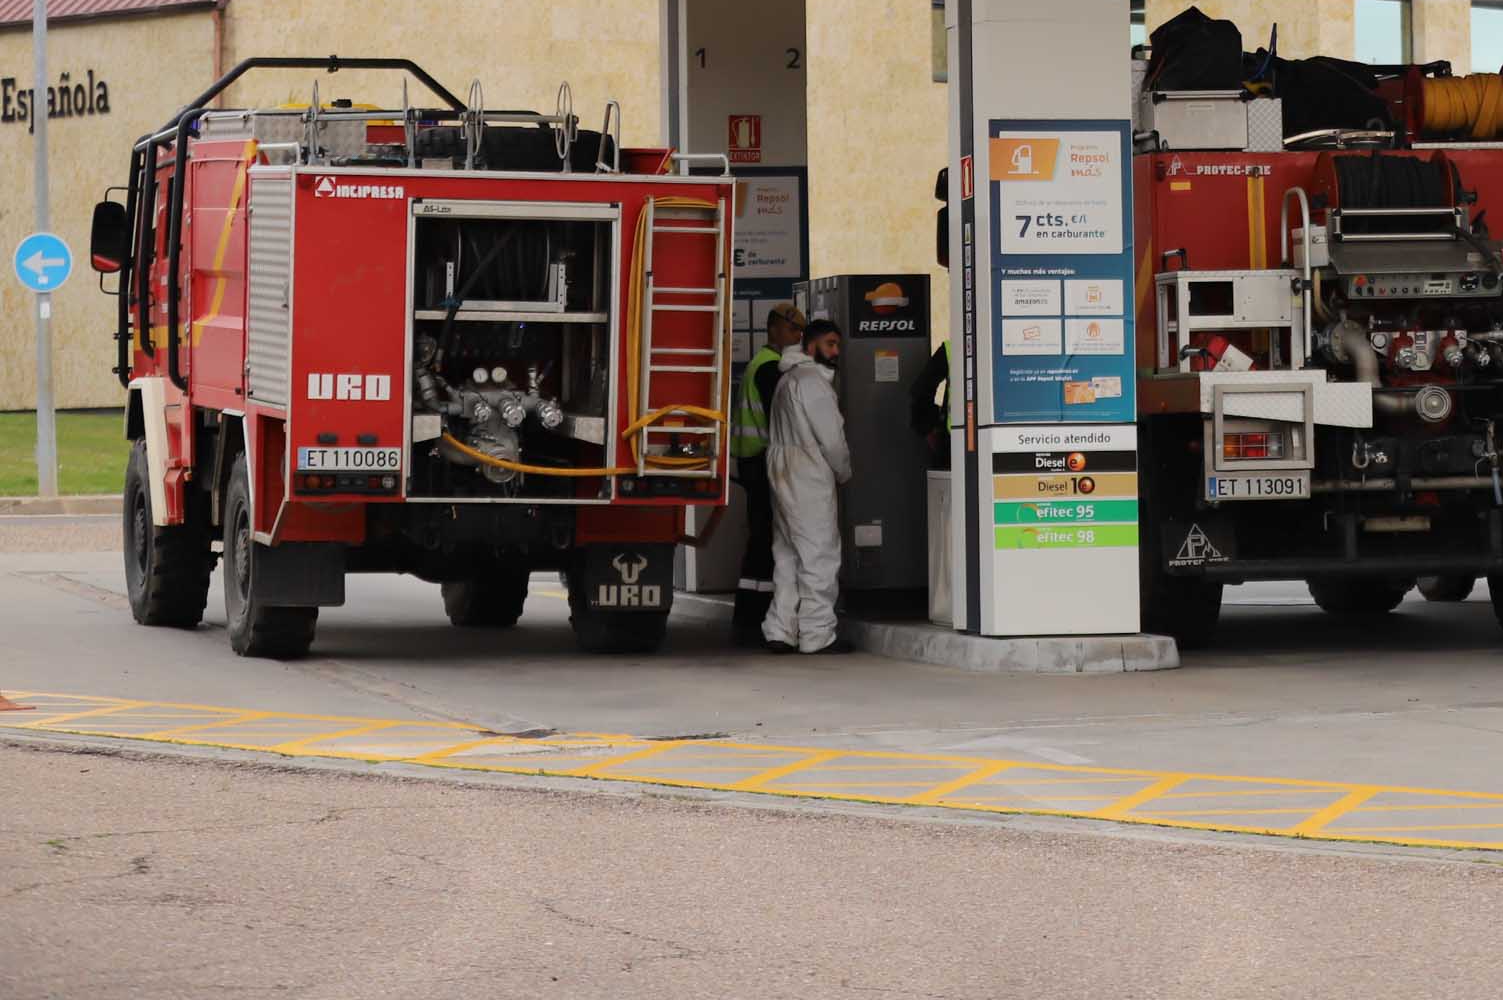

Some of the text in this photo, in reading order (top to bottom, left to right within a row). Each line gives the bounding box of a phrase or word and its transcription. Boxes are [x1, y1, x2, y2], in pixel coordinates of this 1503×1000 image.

[695, 47, 706, 69] 1
[785, 47, 801, 70] 2
[1070, 153, 1109, 165] Repsol
[1197, 165, 1271, 176] PROTEC-FRE
[1015, 215, 1032, 238] 7
[1036, 212, 1069, 227] cts.
[1036, 229, 1105, 239] en carburante
[858, 319, 916, 332] REPSOL
[308, 373, 391, 401] URO
[1017, 432, 1111, 446] Servicio atendido
[307, 450, 398, 467] ET 110086
[1035, 457, 1066, 468] Diesel
[1037, 480, 1068, 493] Diesel
[1217, 478, 1304, 496] ET 113091
[1036, 504, 1095, 518] efitec 95
[1037, 530, 1095, 543] efitec 98
[599, 585, 660, 606] URO
